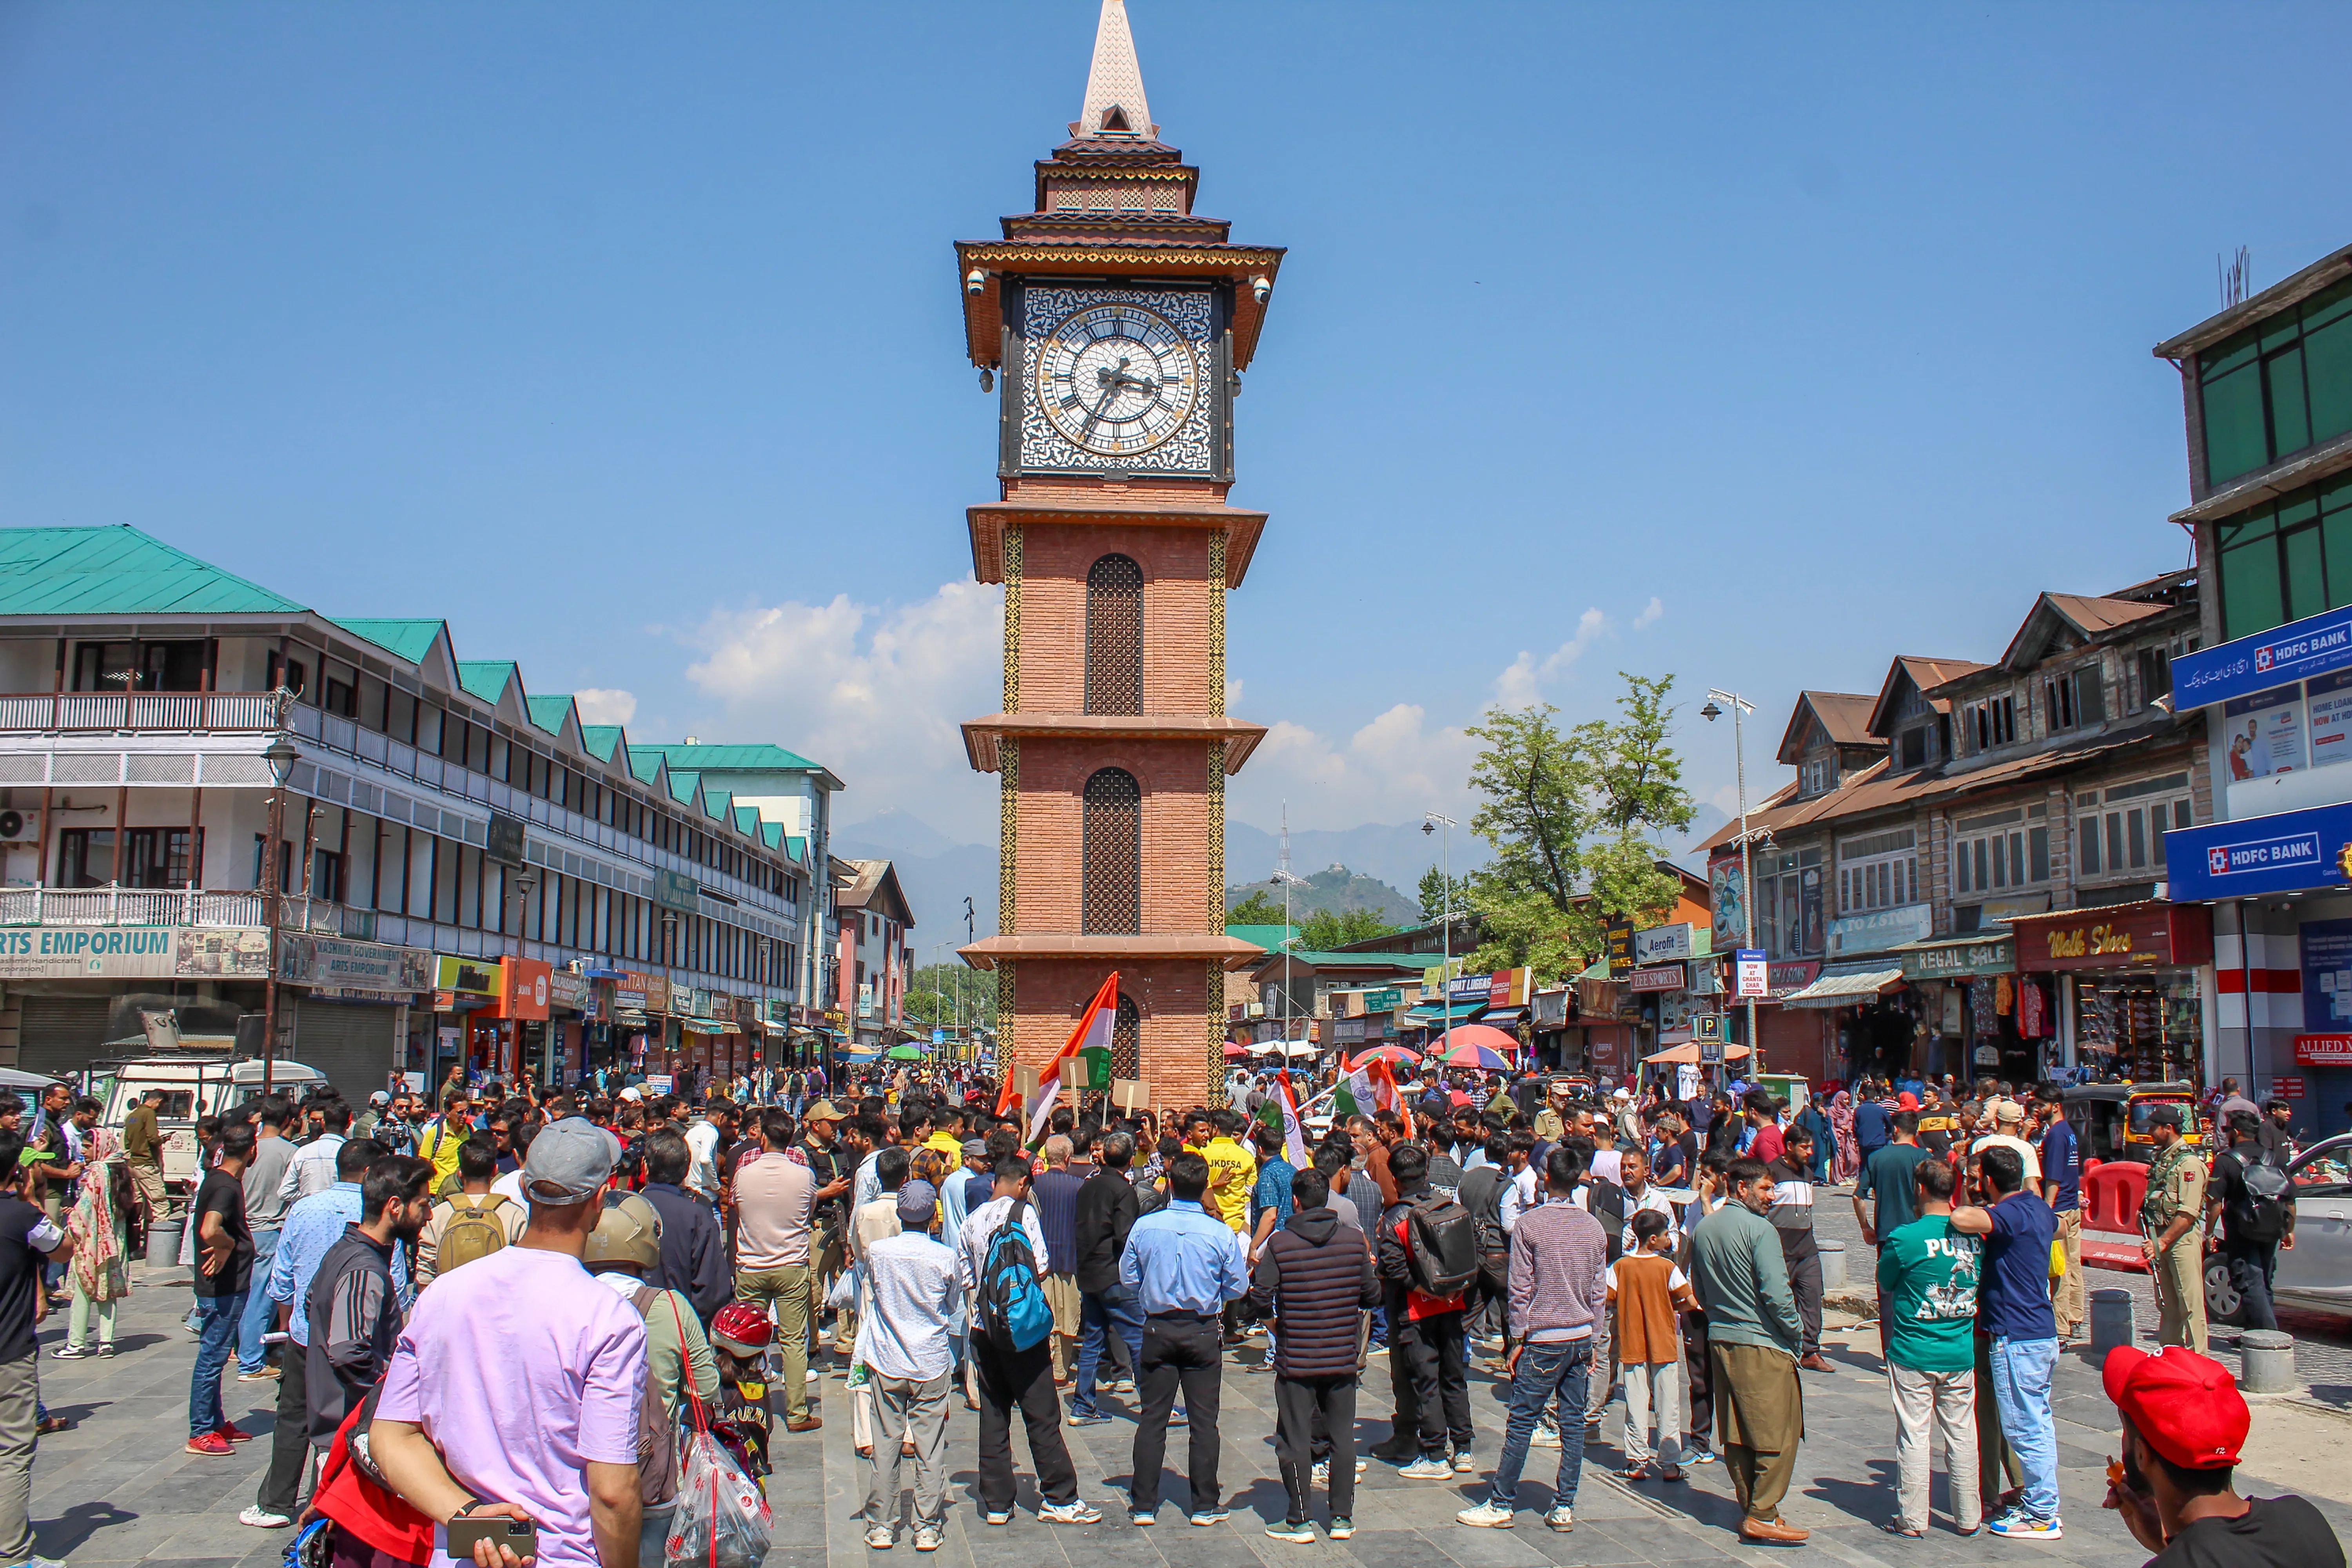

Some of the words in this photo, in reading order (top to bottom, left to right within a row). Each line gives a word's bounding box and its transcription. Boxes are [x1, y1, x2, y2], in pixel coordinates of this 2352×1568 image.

[2276, 643, 2308, 661] HDFC
[2311, 630, 2347, 651] BANK
[2313, 701, 2332, 714] HOME
[2314, 715, 2329, 727] NOW
[2331, 712, 2339, 723] AT
[2232, 848, 2267, 865] HDFC
[2271, 841, 2312, 860] BANK
[1847, 918, 1865, 932] TO
[1867, 916, 1876, 929] Z
[40, 931, 170, 955] EMPORIUM
[1649, 936, 1674, 951] Aerofit
[2047, 928, 2085, 958] Walk
[2090, 923, 2132, 955] Shoes
[316, 941, 352, 956] KASHMIR
[354, 945, 400, 961] GOVERNMENT
[1919, 949, 1962, 969] REGAL
[1969, 945, 2005, 966] SALE
[330, 959, 348, 972] ARTS
[350, 962, 388, 976] EMPORIUM
[1450, 978, 1466, 991] BHAT
[1634, 973, 1648, 986] ZEE
[1706, 1020, 1713, 1032] P
[2299, 1040, 2343, 1052] ALLIED
[1924, 1237, 1981, 1257] PURE
